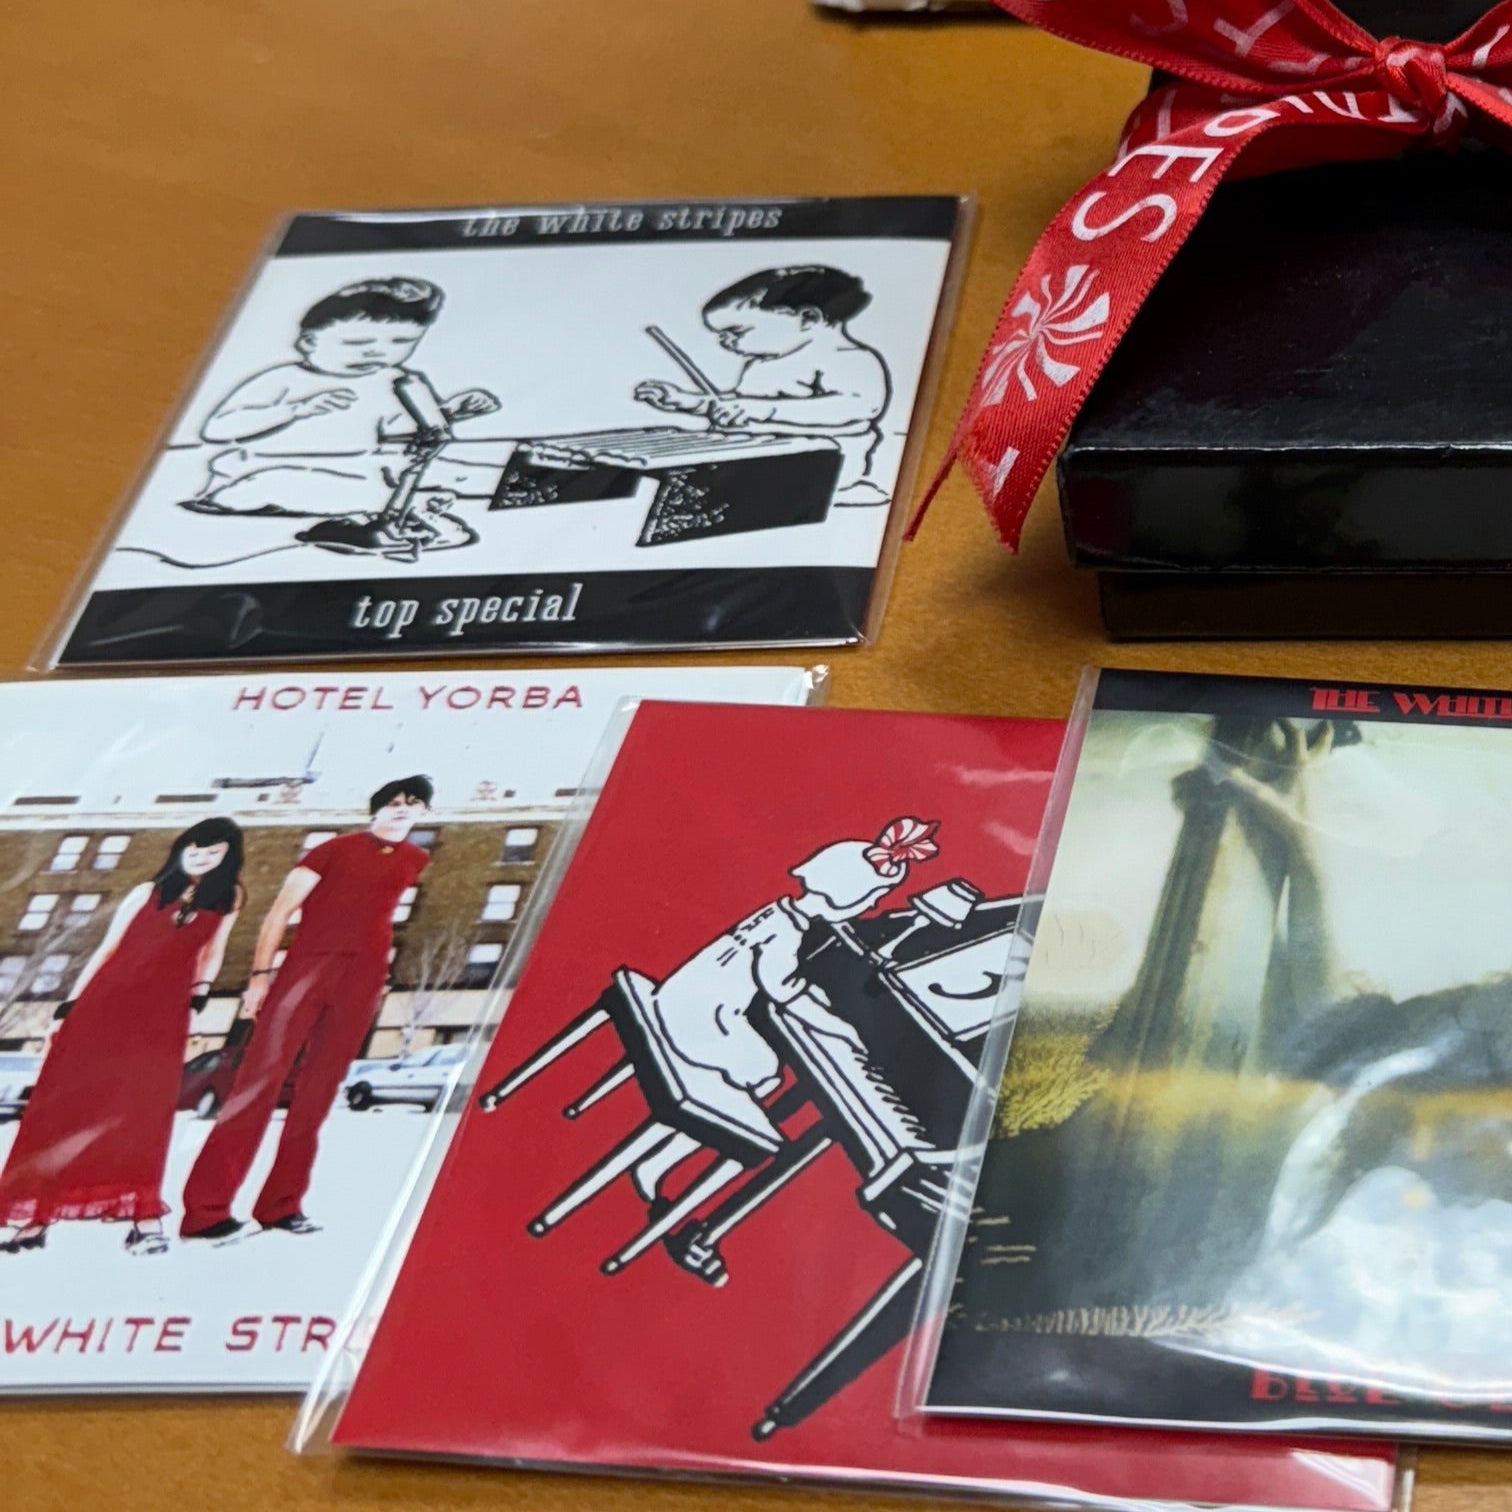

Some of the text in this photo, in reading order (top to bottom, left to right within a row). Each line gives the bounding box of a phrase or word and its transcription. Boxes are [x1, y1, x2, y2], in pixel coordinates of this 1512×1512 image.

[462, 204, 784, 238] the white stripes
[352, 582, 584, 638] top special
[232, 684, 584, 712] HOTEL YORBA
[1311, 686, 1381, 713] THE
[3, 1315, 192, 1354] WHITE
